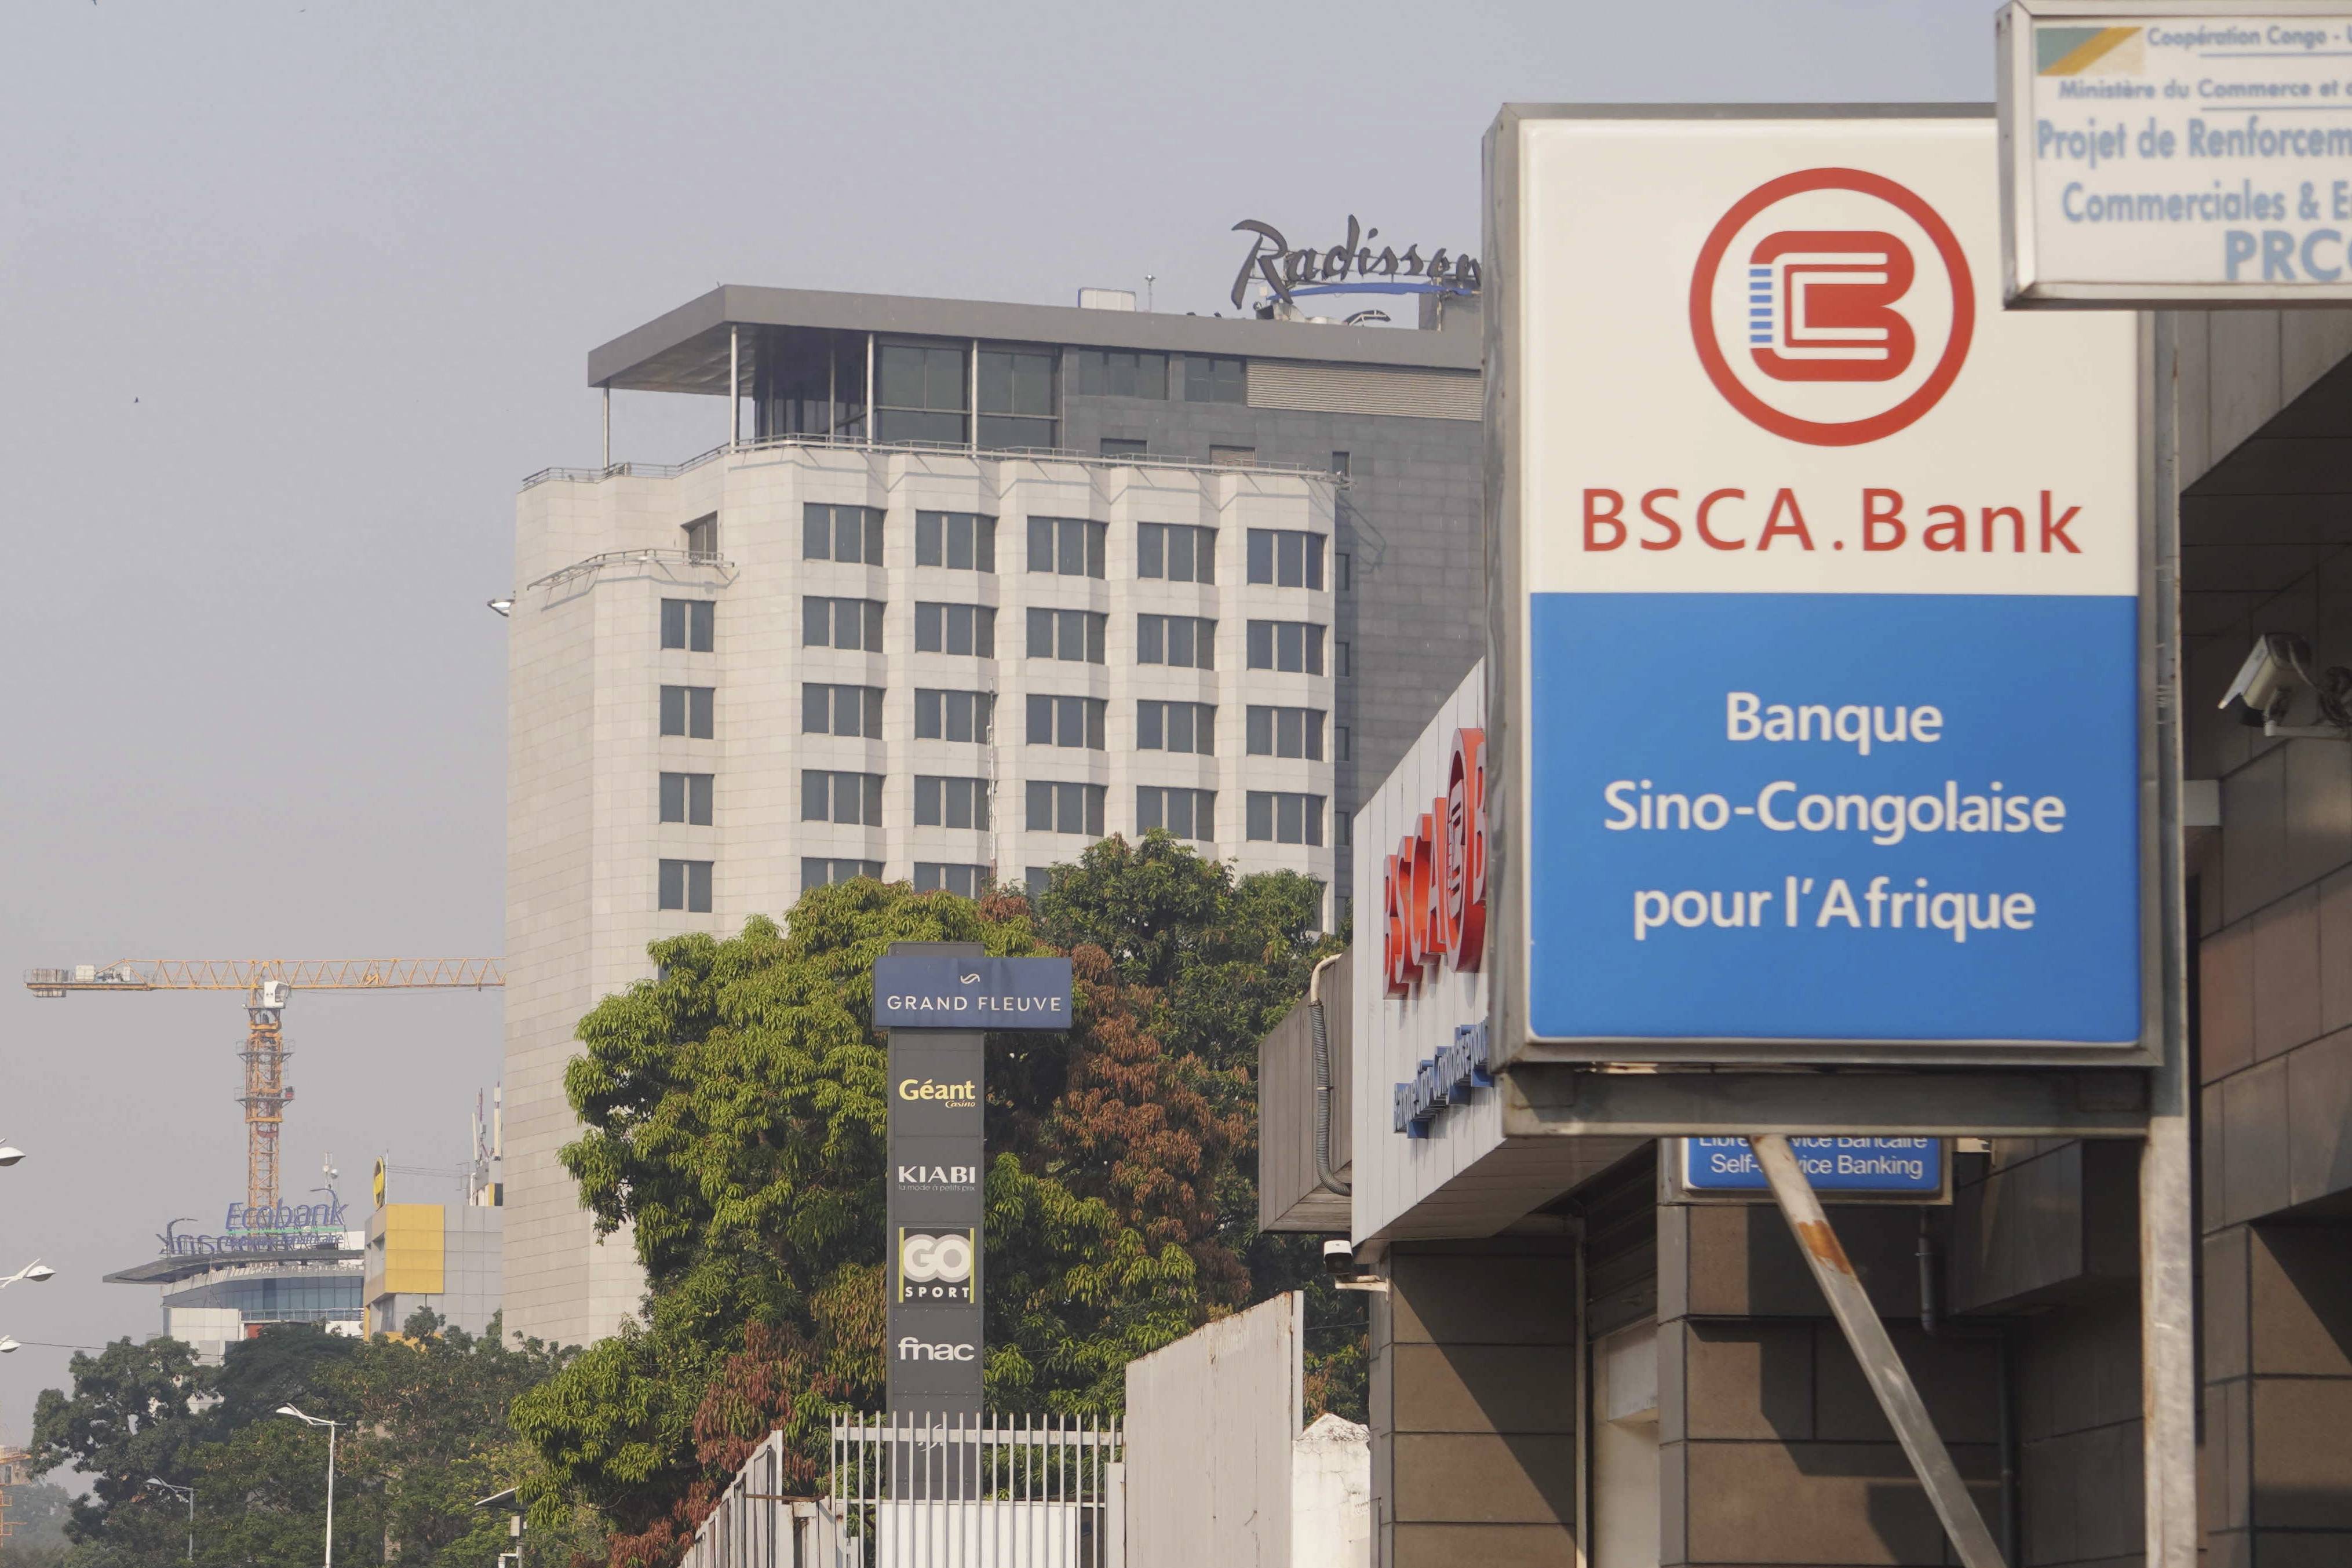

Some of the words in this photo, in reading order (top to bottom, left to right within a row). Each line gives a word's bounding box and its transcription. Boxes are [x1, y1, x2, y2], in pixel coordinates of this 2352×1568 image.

[2147, 26, 2260, 50] Coopération
[2266, 25, 2328, 50] Congo
[2058, 79, 2156, 99] Ministère
[2164, 79, 2190, 99] du
[2198, 79, 2311, 98] Commerce
[2320, 79, 2338, 97] et
[2037, 118, 2127, 169] Projet
[2138, 116, 2176, 158] de
[2062, 178, 2286, 223] Commerciales
[2298, 181, 2320, 221] &
[1231, 214, 1482, 311] Radisson
[2224, 228, 2352, 282] PRC
[1582, 487, 2083, 555] BSCA.Bank
[1725, 692, 1943, 756] Banque
[1603, 780, 2066, 845] Sino-Congolaise
[1383, 797, 1449, 1000] BSCA
[1633, 888, 1772, 940] pour
[1785, 876, 2036, 943] l'Afrique
[887, 995, 968, 1010] GRAND
[978, 996, 1062, 1011] FLEUVE
[899, 1078, 976, 1100] Géant
[945, 1100, 976, 1108] Casino
[898, 1165, 976, 1183] KIABI
[1837, 1154, 1923, 1180] Banking
[225, 1188, 349, 1231] Ecobank
[903, 1239, 972, 1278] GO
[905, 1286, 969, 1298] SPORT
[898, 1336, 975, 1361] fnac
